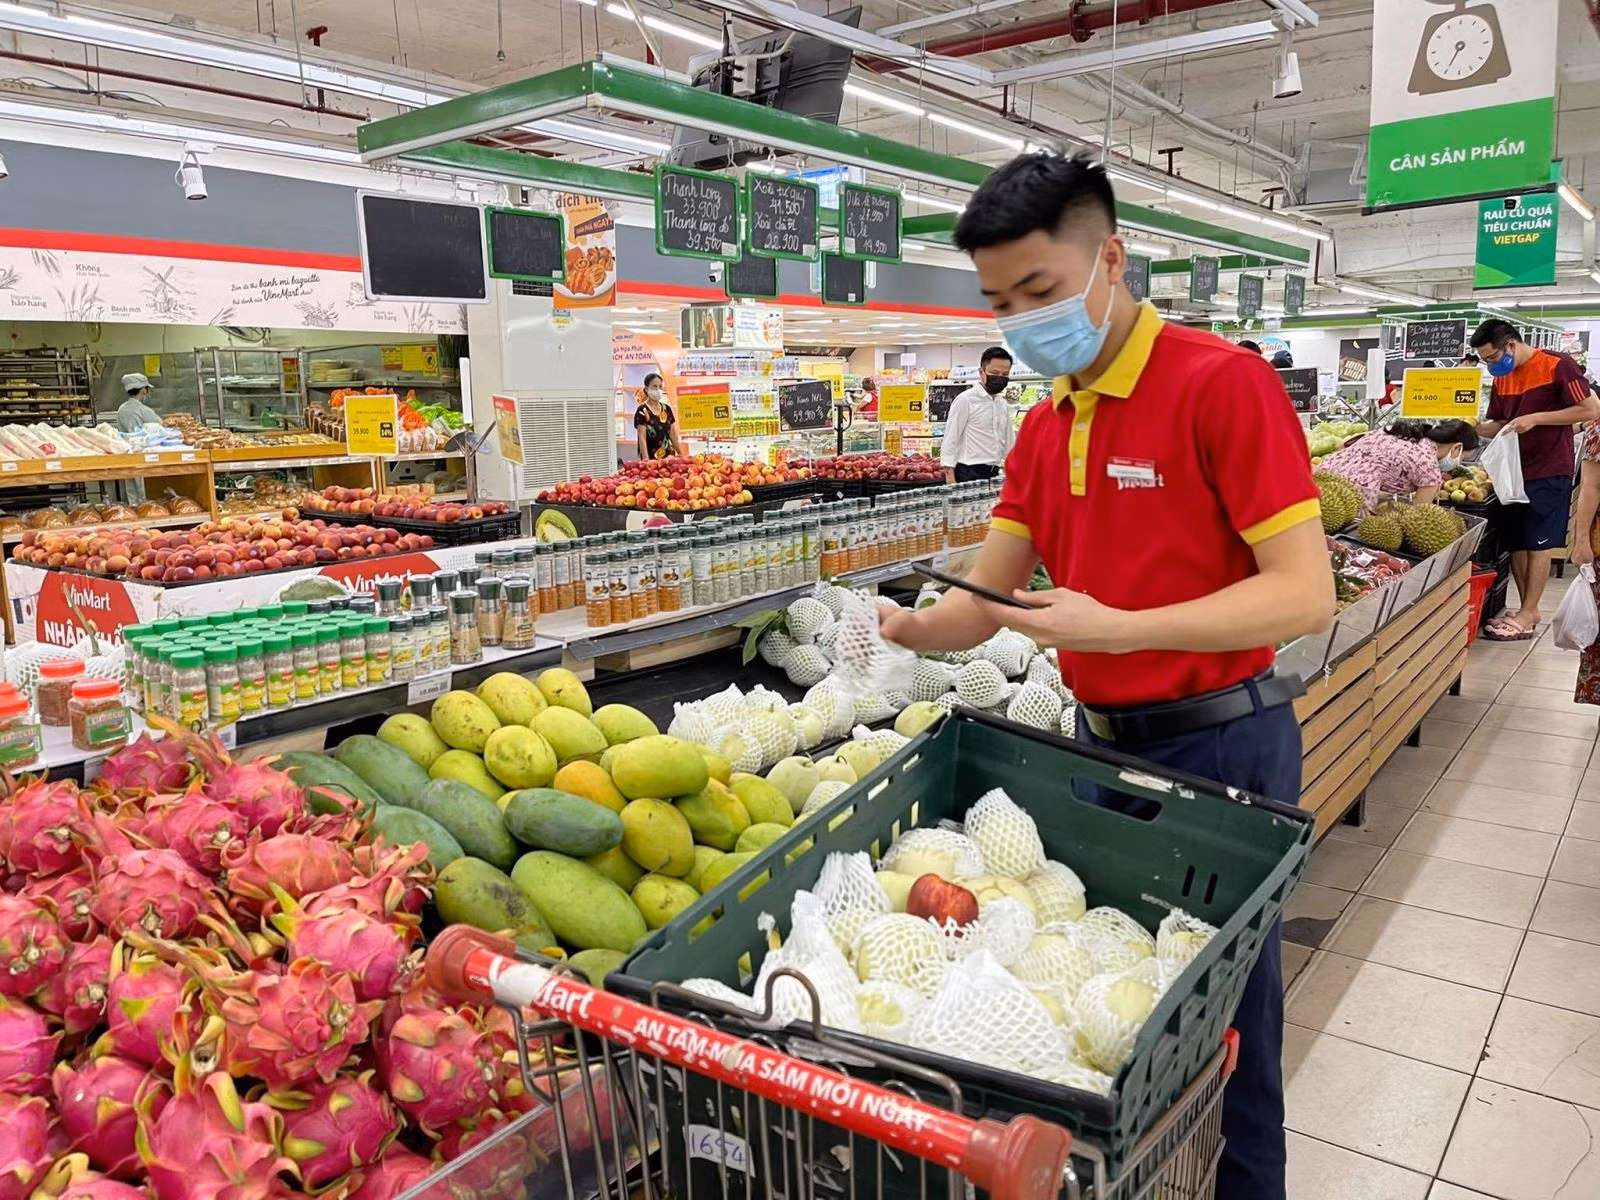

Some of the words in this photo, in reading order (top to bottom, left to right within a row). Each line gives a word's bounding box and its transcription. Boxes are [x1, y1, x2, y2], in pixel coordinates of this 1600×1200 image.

[1390, 153, 1426, 172] CÂN
[1430, 147, 1466, 166] SẢN
[1471, 138, 1525, 160] PHẨM
[663, 174, 698, 198] Thanh
[700, 180, 722, 207] Long
[683, 198, 719, 220] 33.900
[769, 198, 800, 215] 41.500
[663, 209, 698, 230] Thanh
[1484, 210, 1507, 221] RAU
[1484, 221, 1508, 233] TIÊU
[686, 231, 722, 252] 39.500
[764, 234, 799, 251] 22.900
[1494, 233, 1540, 245] VIETGAP
[75, 263, 101, 273] Không
[291, 274, 320, 288] baguette
[634, 1016, 665, 1042] AN
